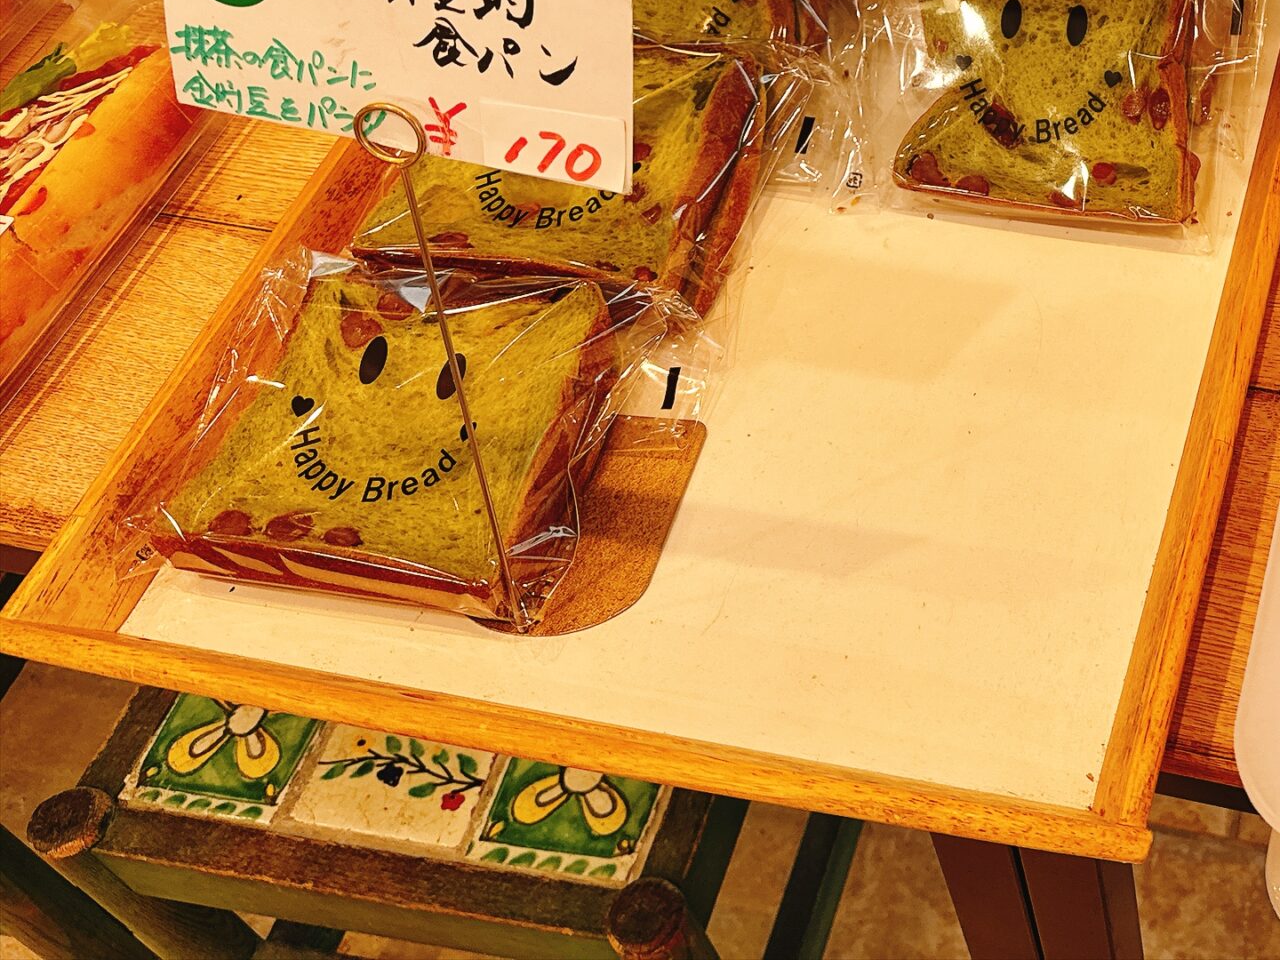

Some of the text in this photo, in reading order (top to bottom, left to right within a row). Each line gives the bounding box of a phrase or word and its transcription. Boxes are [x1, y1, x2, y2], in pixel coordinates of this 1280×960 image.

[412, 17, 579, 87] 食パン
[1035, 92, 1107, 144] Bread
[475, 169, 529, 229] Happy
[289, 425, 458, 503] Happy Bread
